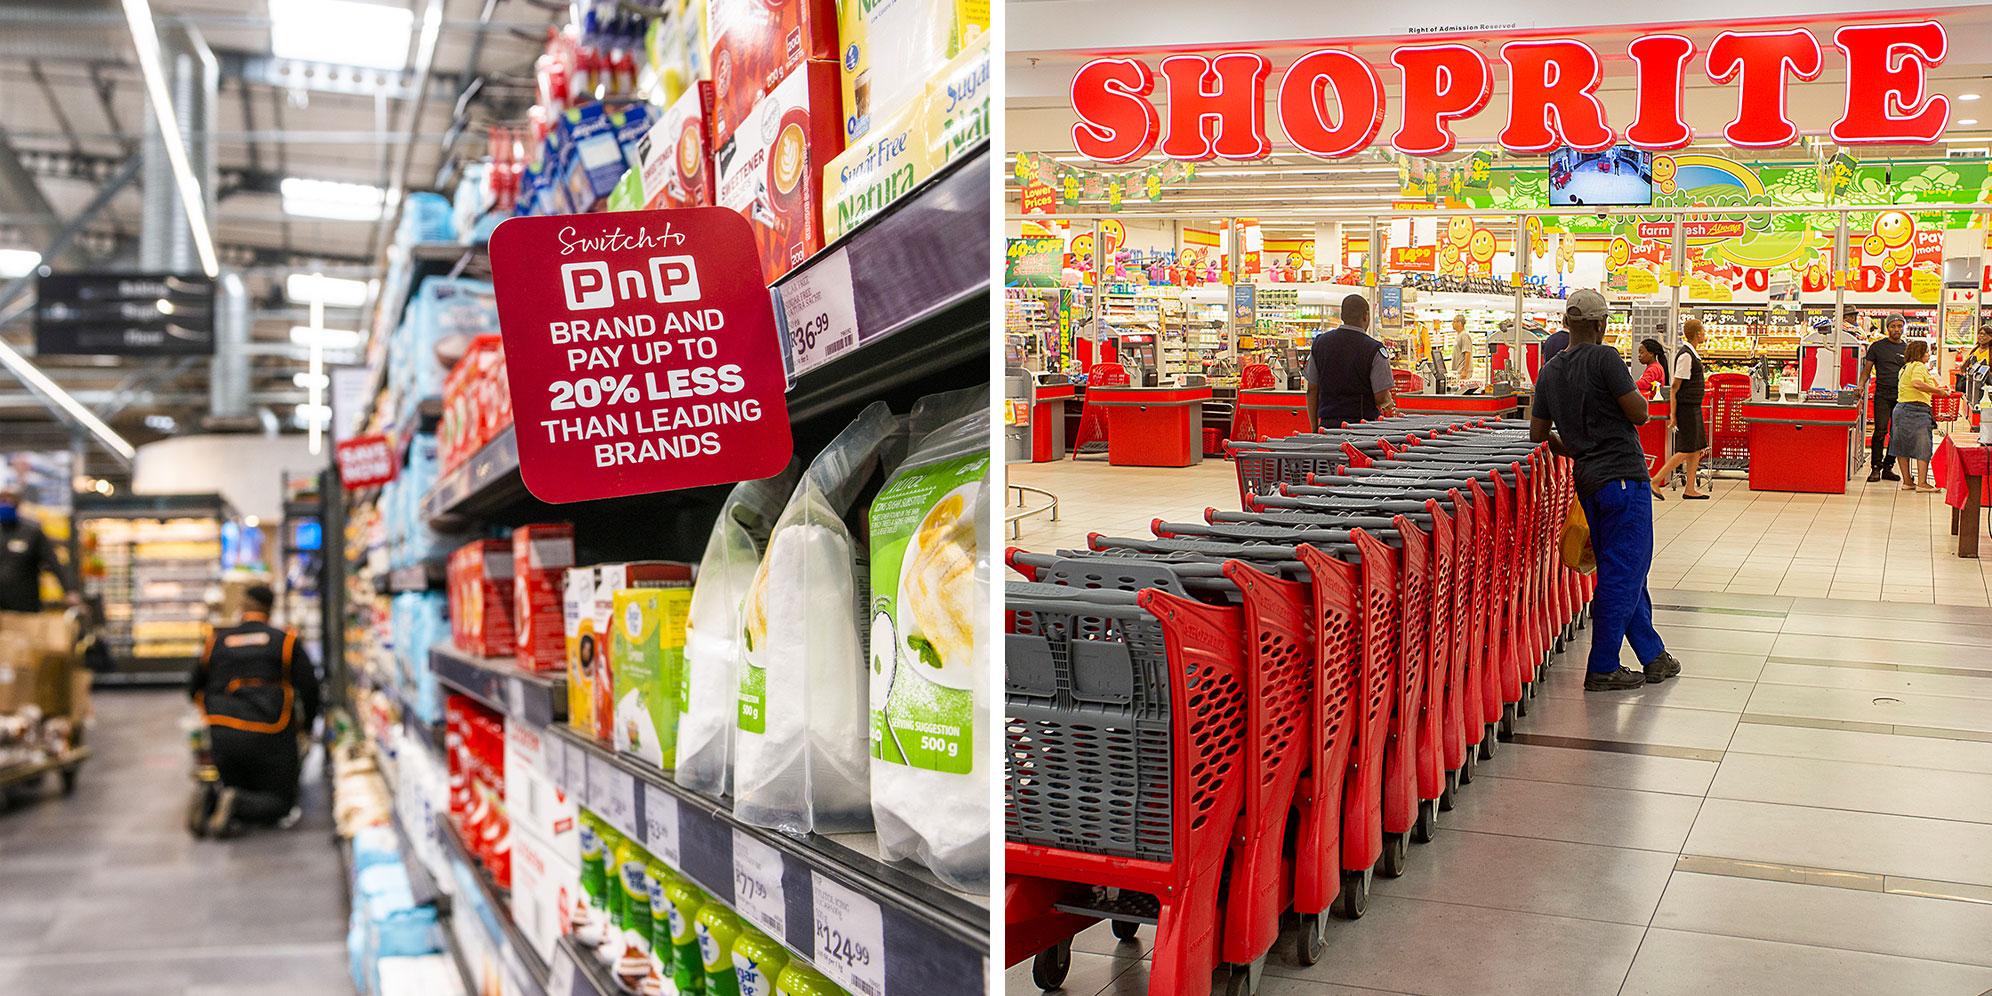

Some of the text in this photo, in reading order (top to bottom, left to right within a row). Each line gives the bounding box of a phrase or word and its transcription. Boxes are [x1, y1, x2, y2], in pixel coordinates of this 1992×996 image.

[1439, 25, 1479, 33] Admission
[1480, 22, 1516, 30] Reserved
[787, 34, 800, 52] 200
[766, 65, 784, 88] 200 g
[1070, 19, 1950, 165] SHOPRITE
[840, 149, 877, 192] Sugar
[877, 132, 908, 168] Free
[1472, 160, 1491, 171] 0%
[1834, 163, 1853, 178] 0%
[721, 147, 765, 201] SWEETENER
[1472, 170, 1491, 182] FF
[837, 162, 914, 237] Natura
[1024, 185, 1051, 199] Lower
[1063, 187, 1079, 200] OFF
[1024, 196, 1052, 209] Prices
[1641, 224, 1670, 236] farm
[1707, 223, 1742, 236] Always
[558, 221, 686, 256] Switch to
[1918, 232, 1944, 246] Pay
[1007, 239, 1064, 258] 40% OFF
[1916, 245, 1942, 255] more
[790, 249, 804, 266] 200
[1019, 253, 1051, 266] BACK
[1691, 260, 1712, 268] Prices
[1013, 264, 1055, 276] SCHOOL
[1467, 261, 1491, 274] 2020
[561, 254, 701, 311] PnP
[799, 286, 812, 301] FREE
[549, 309, 725, 345] BRAND AND
[1060, 309, 1070, 351] PRICES
[567, 336, 718, 372] PAY UP TO
[548, 363, 746, 412] 20% LESS
[540, 398, 763, 444] THAN LEADING
[594, 431, 722, 469] BRANDS
[1007, 583, 1064, 596] OPRITE
[742, 704, 759, 720] 500 g
[890, 718, 961, 737] SERVING SUGGESTION
[920, 735, 958, 757] 500 g
[816, 920, 870, 968] R124.99
